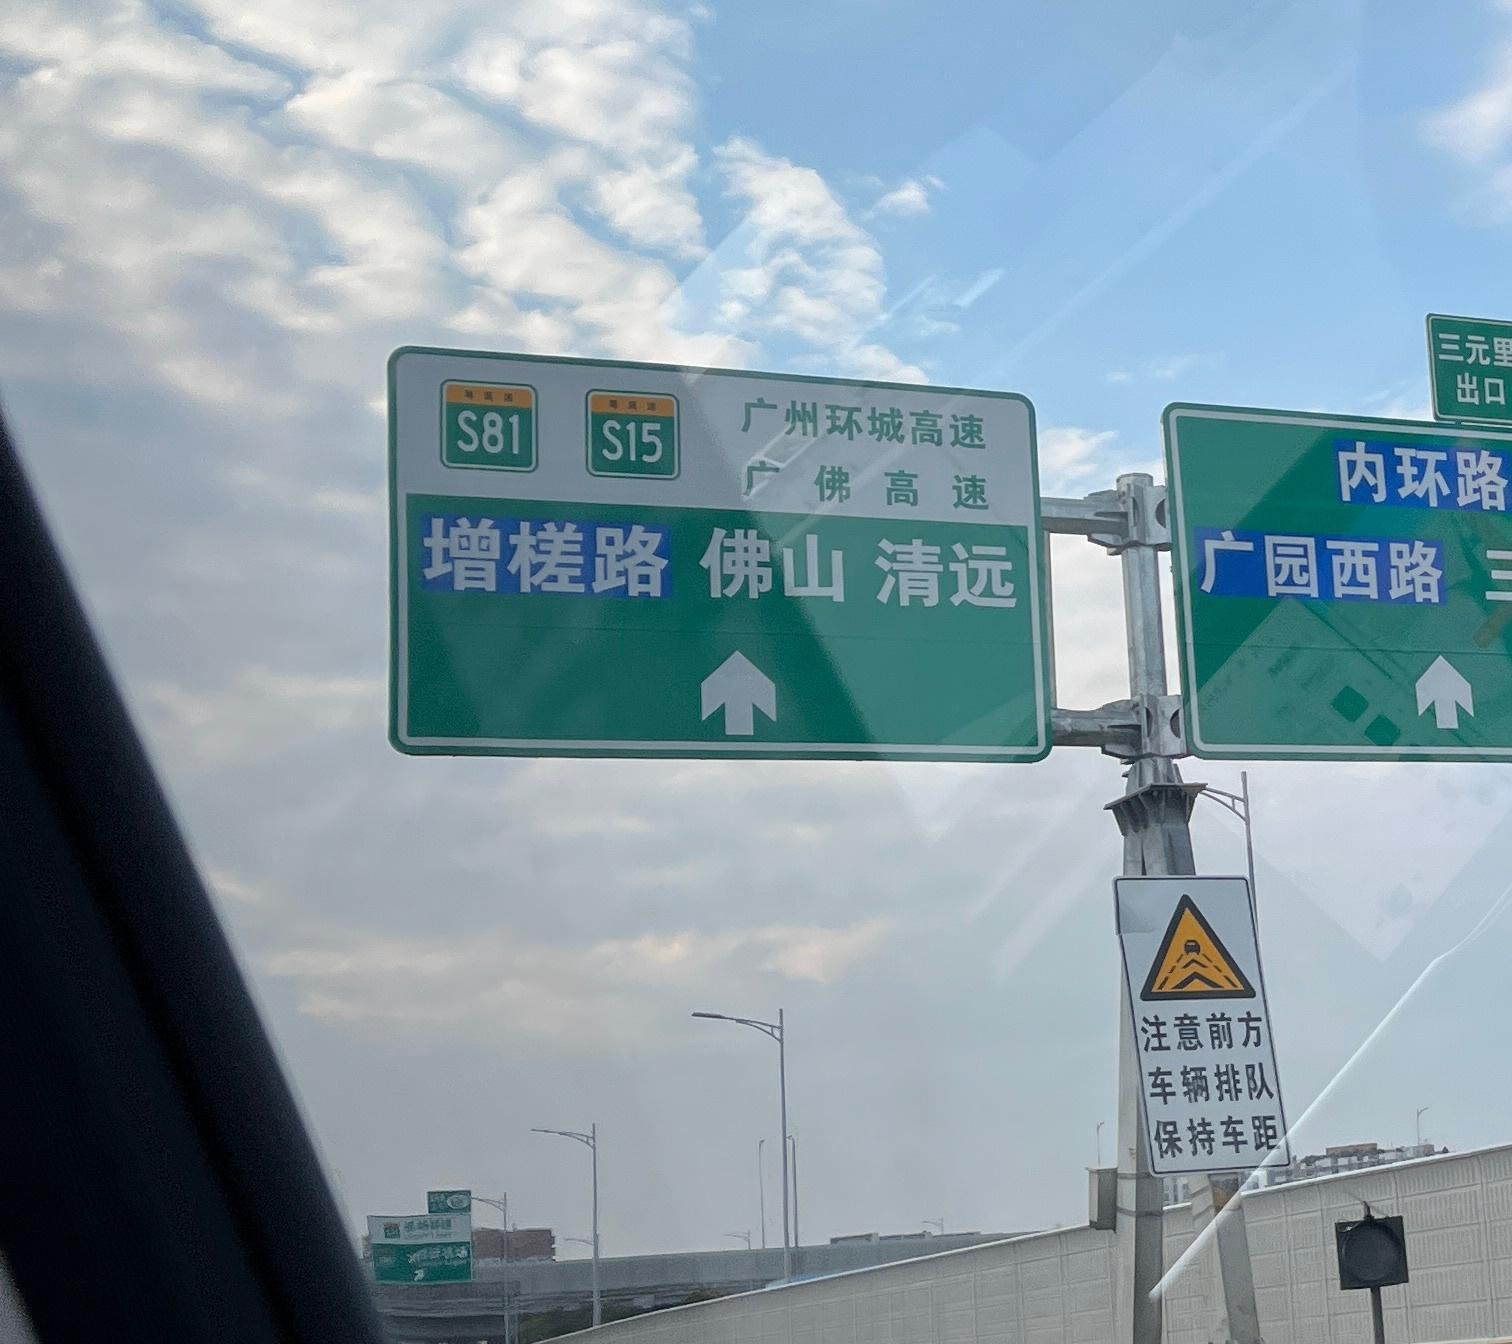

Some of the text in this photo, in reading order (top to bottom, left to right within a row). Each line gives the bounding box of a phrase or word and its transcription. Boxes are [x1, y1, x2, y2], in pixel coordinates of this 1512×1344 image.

[1455, 373, 1507, 406] 出口
[457, 410, 520, 454] S81
[602, 419, 663, 463] S15
[740, 396, 988, 450] 广州环城高速
[1337, 441, 1510, 512] 内环路
[422, 516, 1018, 609] 增槎路 佛山 清远
[1200, 530, 1444, 605] 广园西路
[1140, 1011, 1263, 1052] 注意前方
[1147, 1062, 1275, 1105] 车辆排队
[1153, 1114, 1281, 1158] 保持车距
